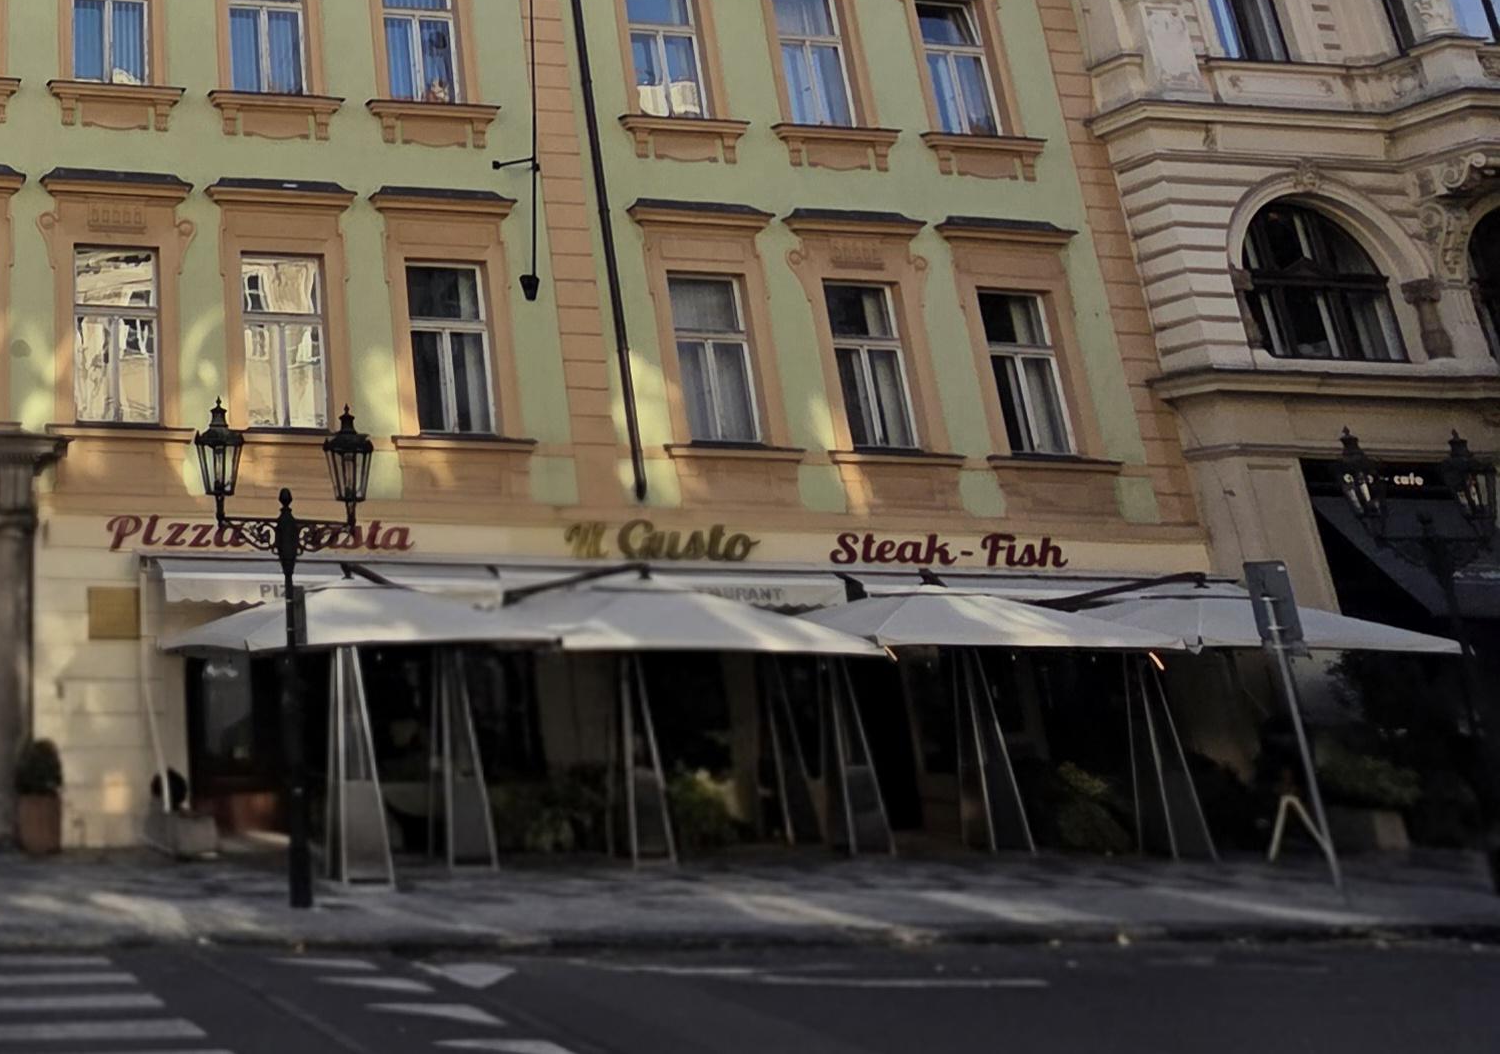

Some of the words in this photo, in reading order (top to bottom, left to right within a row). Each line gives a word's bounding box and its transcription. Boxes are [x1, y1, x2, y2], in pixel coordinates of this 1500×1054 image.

[286, 519, 415, 552] asta
[616, 519, 761, 562] Gusto
[829, 532, 958, 565] Steak
[981, 533, 1069, 568] Fish
